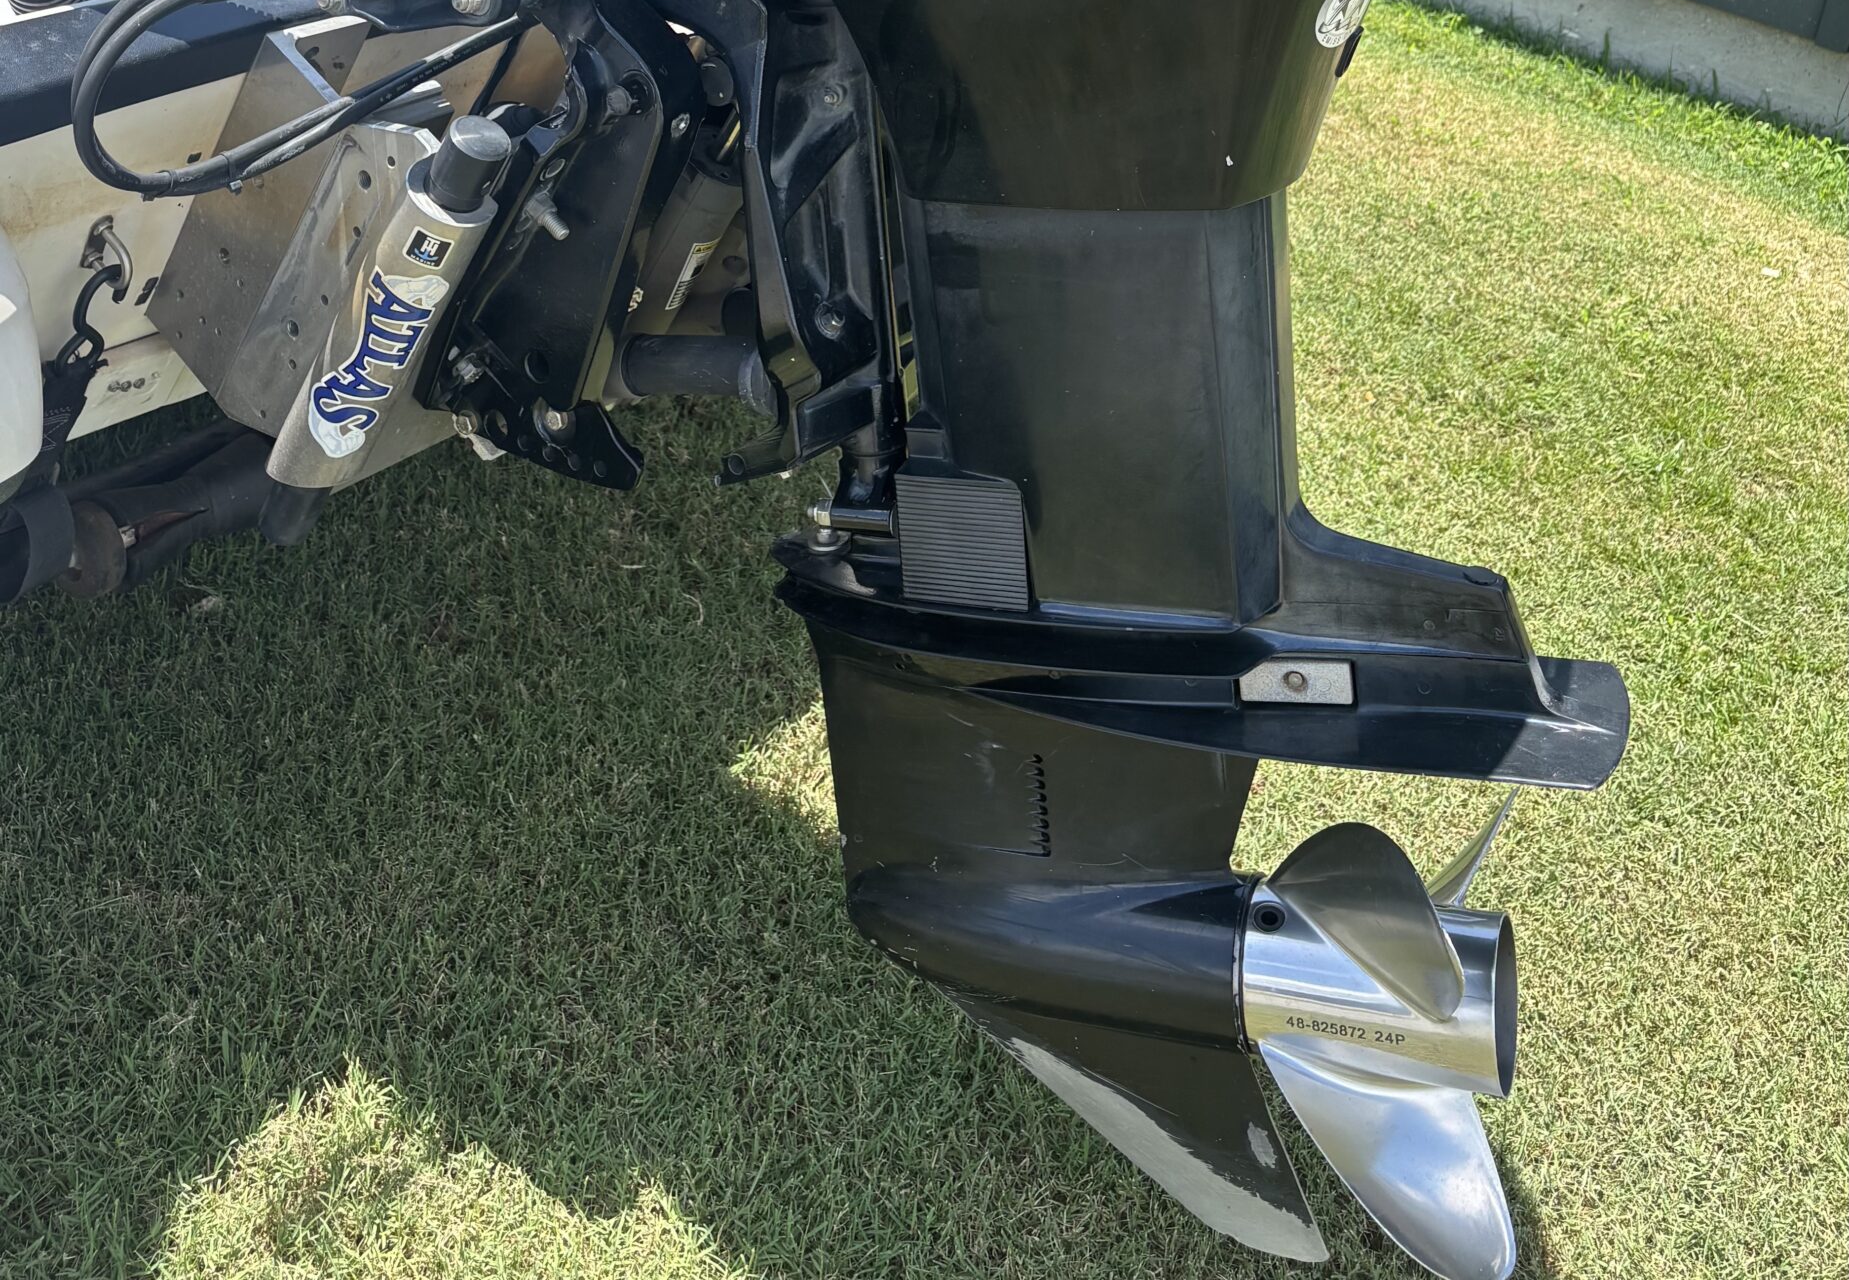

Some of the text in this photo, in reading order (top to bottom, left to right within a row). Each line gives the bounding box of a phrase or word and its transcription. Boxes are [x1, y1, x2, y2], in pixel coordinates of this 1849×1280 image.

[312, 268, 433, 431] ATLAS
[1286, 1016, 1406, 1045] 48-825872 24P
